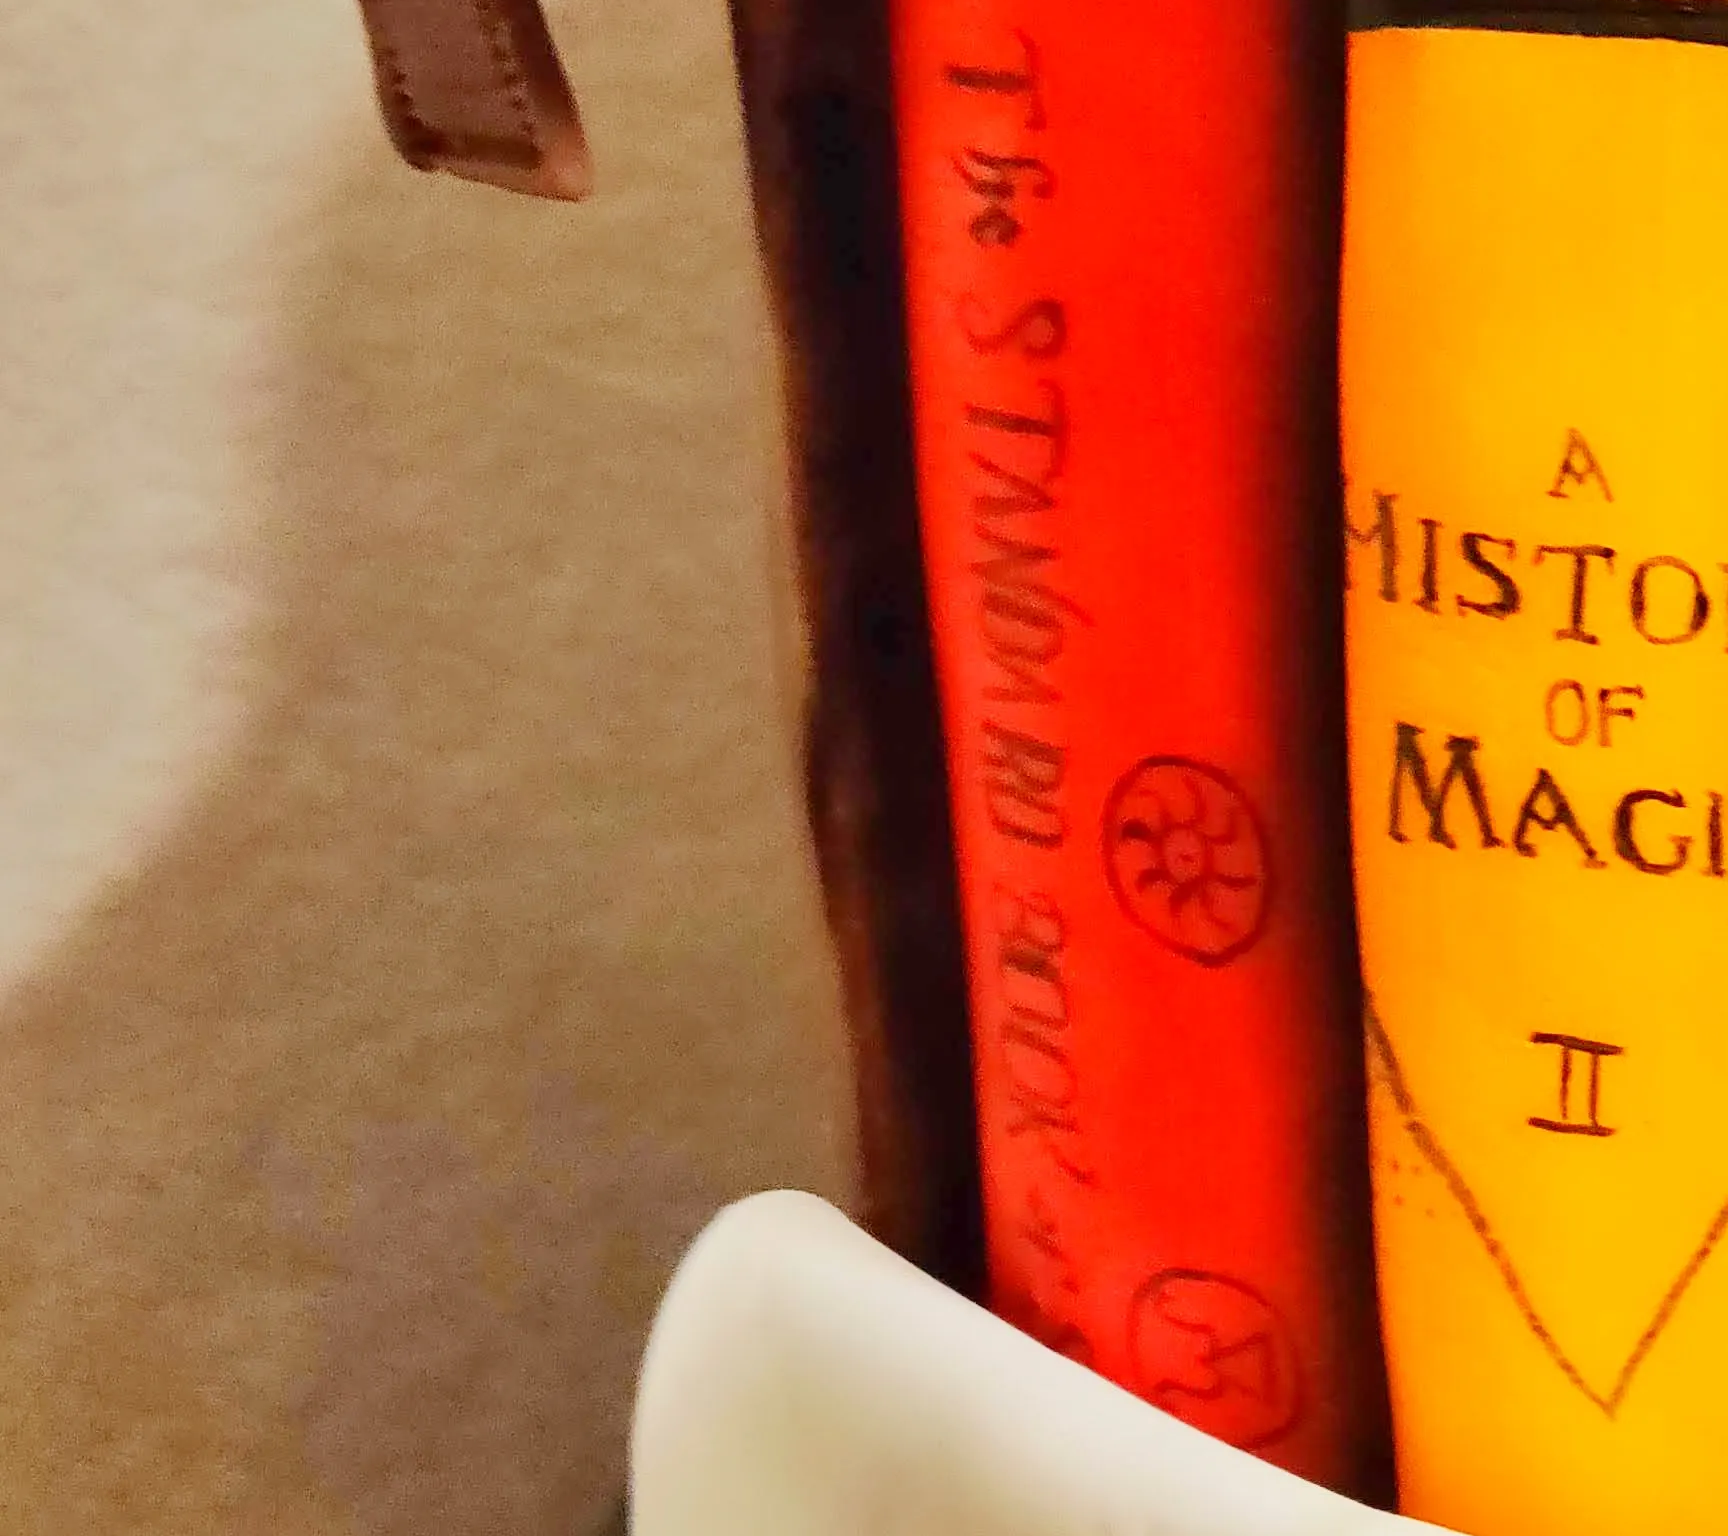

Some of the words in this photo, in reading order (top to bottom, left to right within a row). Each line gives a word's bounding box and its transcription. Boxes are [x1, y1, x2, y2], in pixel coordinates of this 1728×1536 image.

[943, 26, 1055, 247] The
[1545, 426, 1616, 504] A
[1544, 677, 1646, 749] OF
[1526, 1030, 1626, 1138] II
